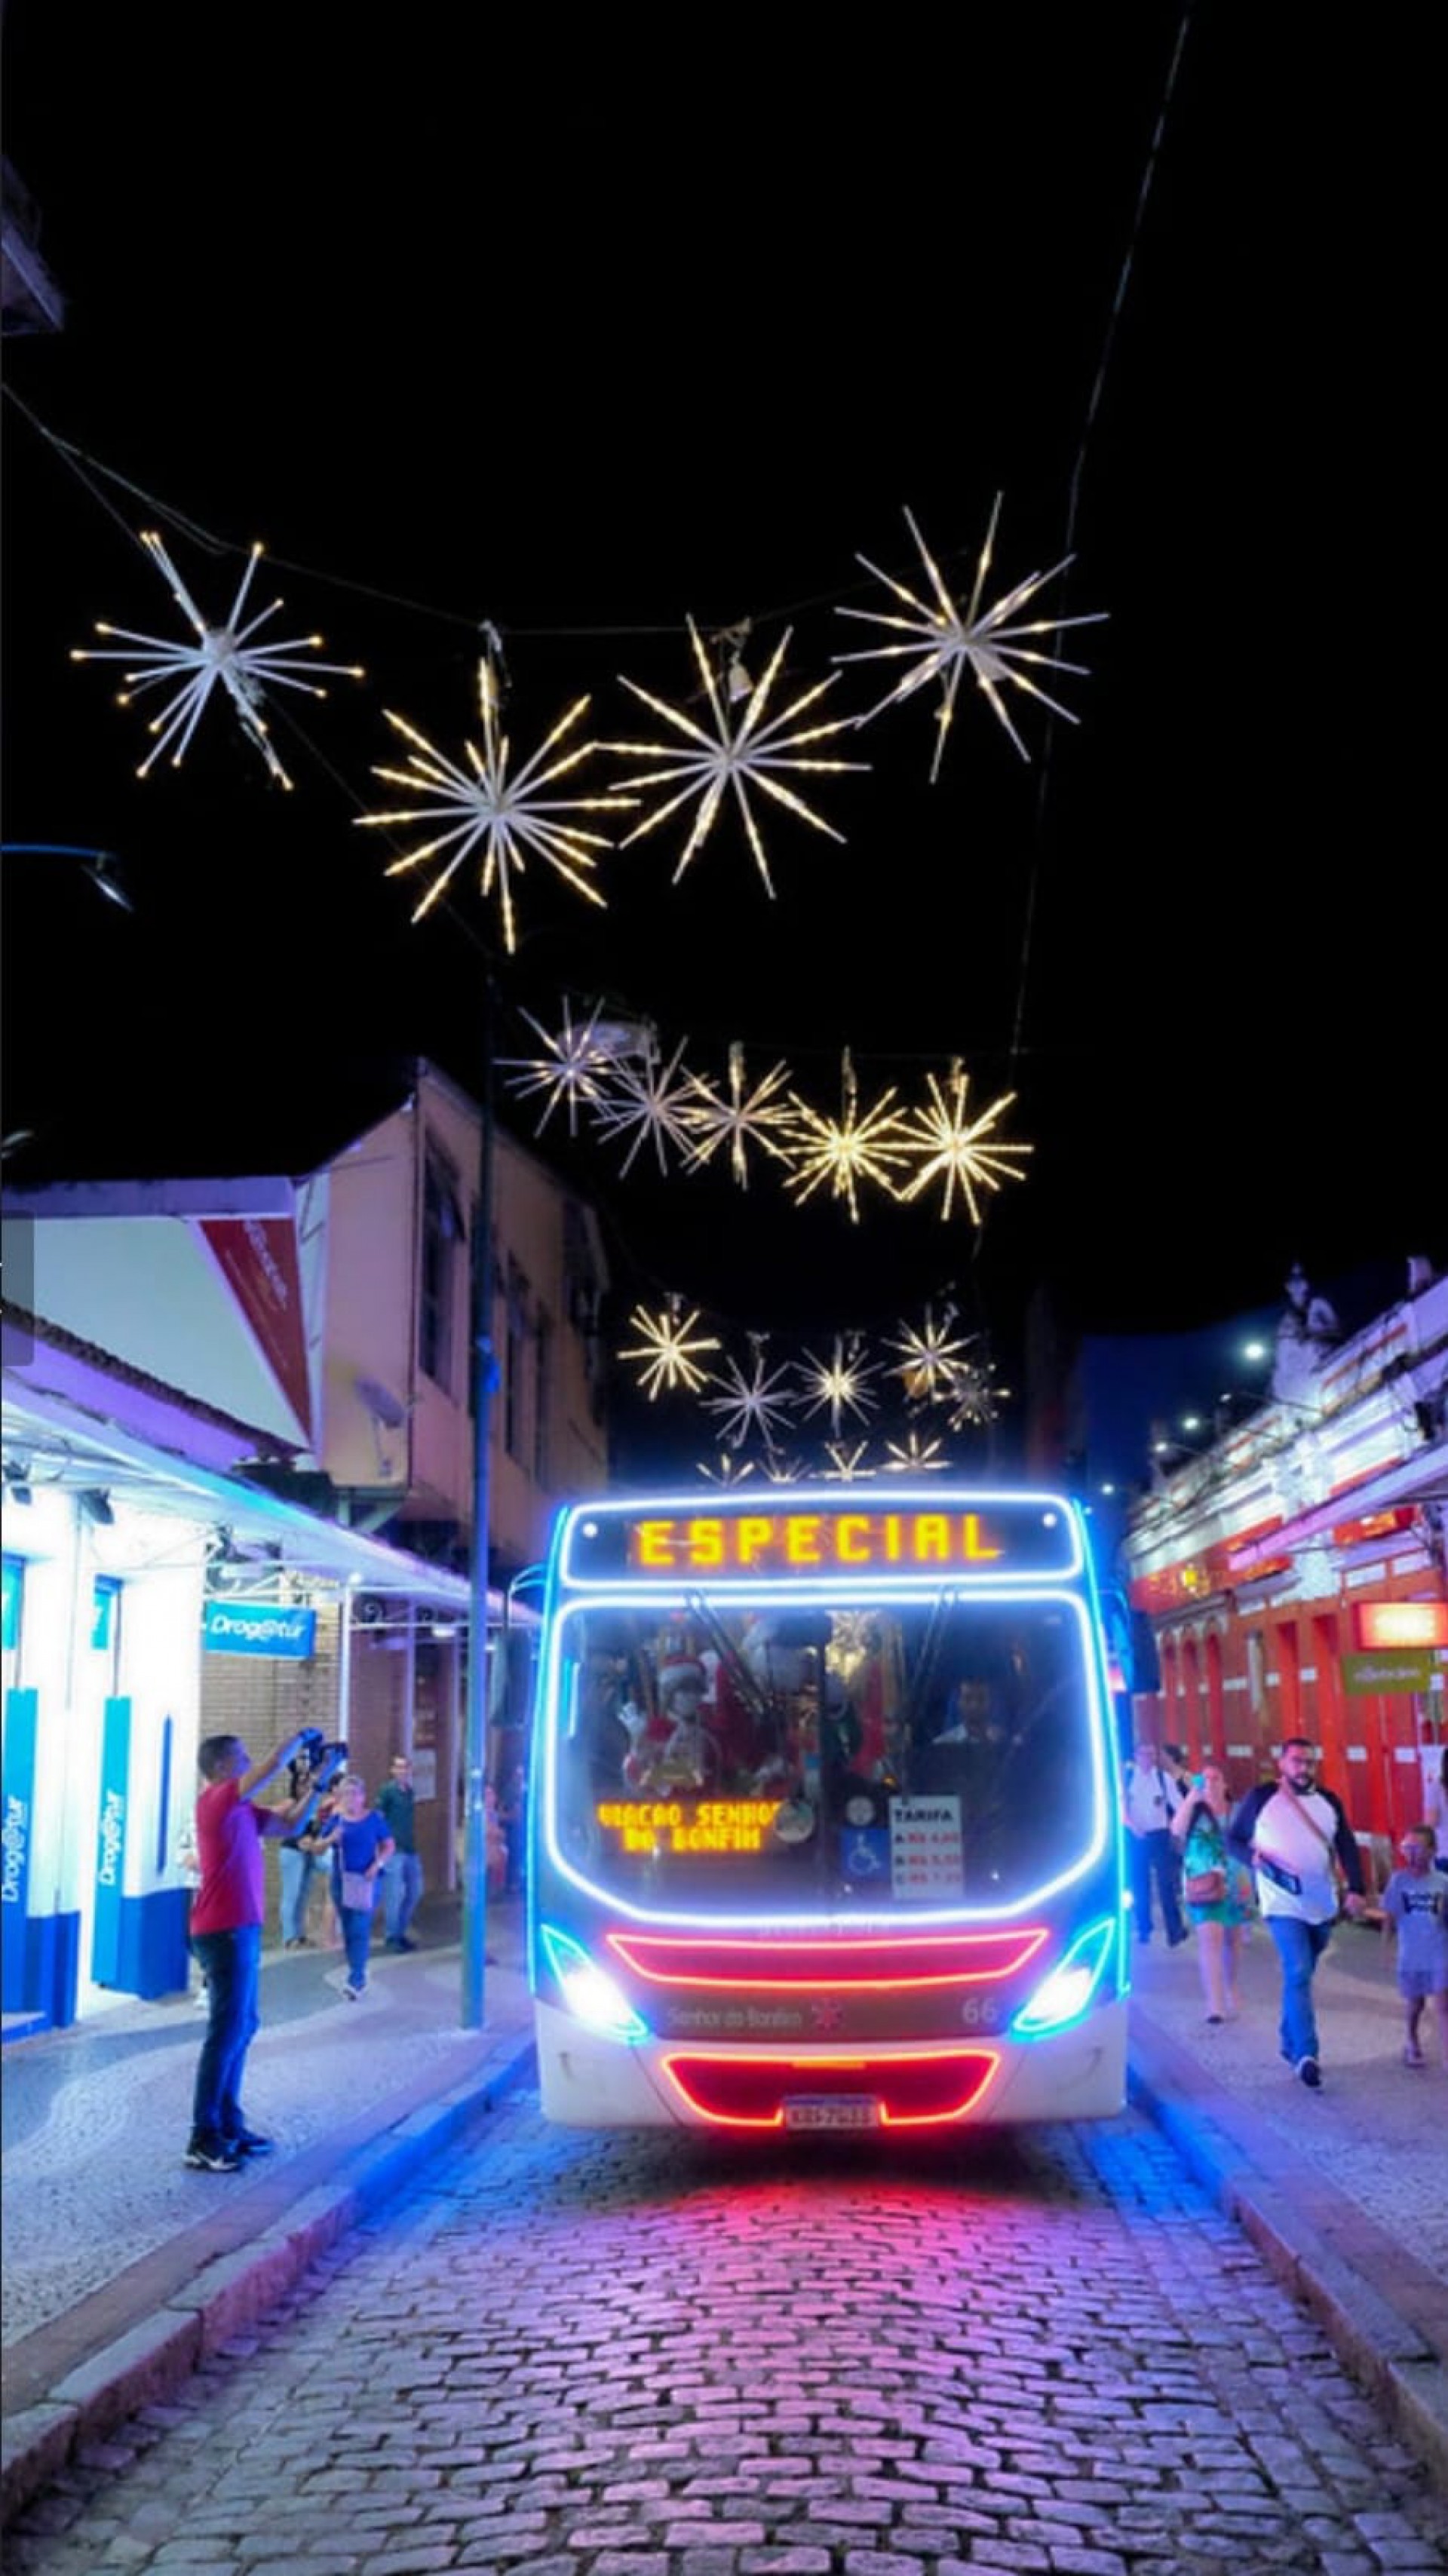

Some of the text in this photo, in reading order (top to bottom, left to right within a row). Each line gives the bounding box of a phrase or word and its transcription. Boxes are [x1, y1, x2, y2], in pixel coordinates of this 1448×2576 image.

[638, 1513, 1003, 1566] ESPECIAL
[895, 1808, 953, 1823] TARIFA
[962, 1997, 999, 2024] 66
